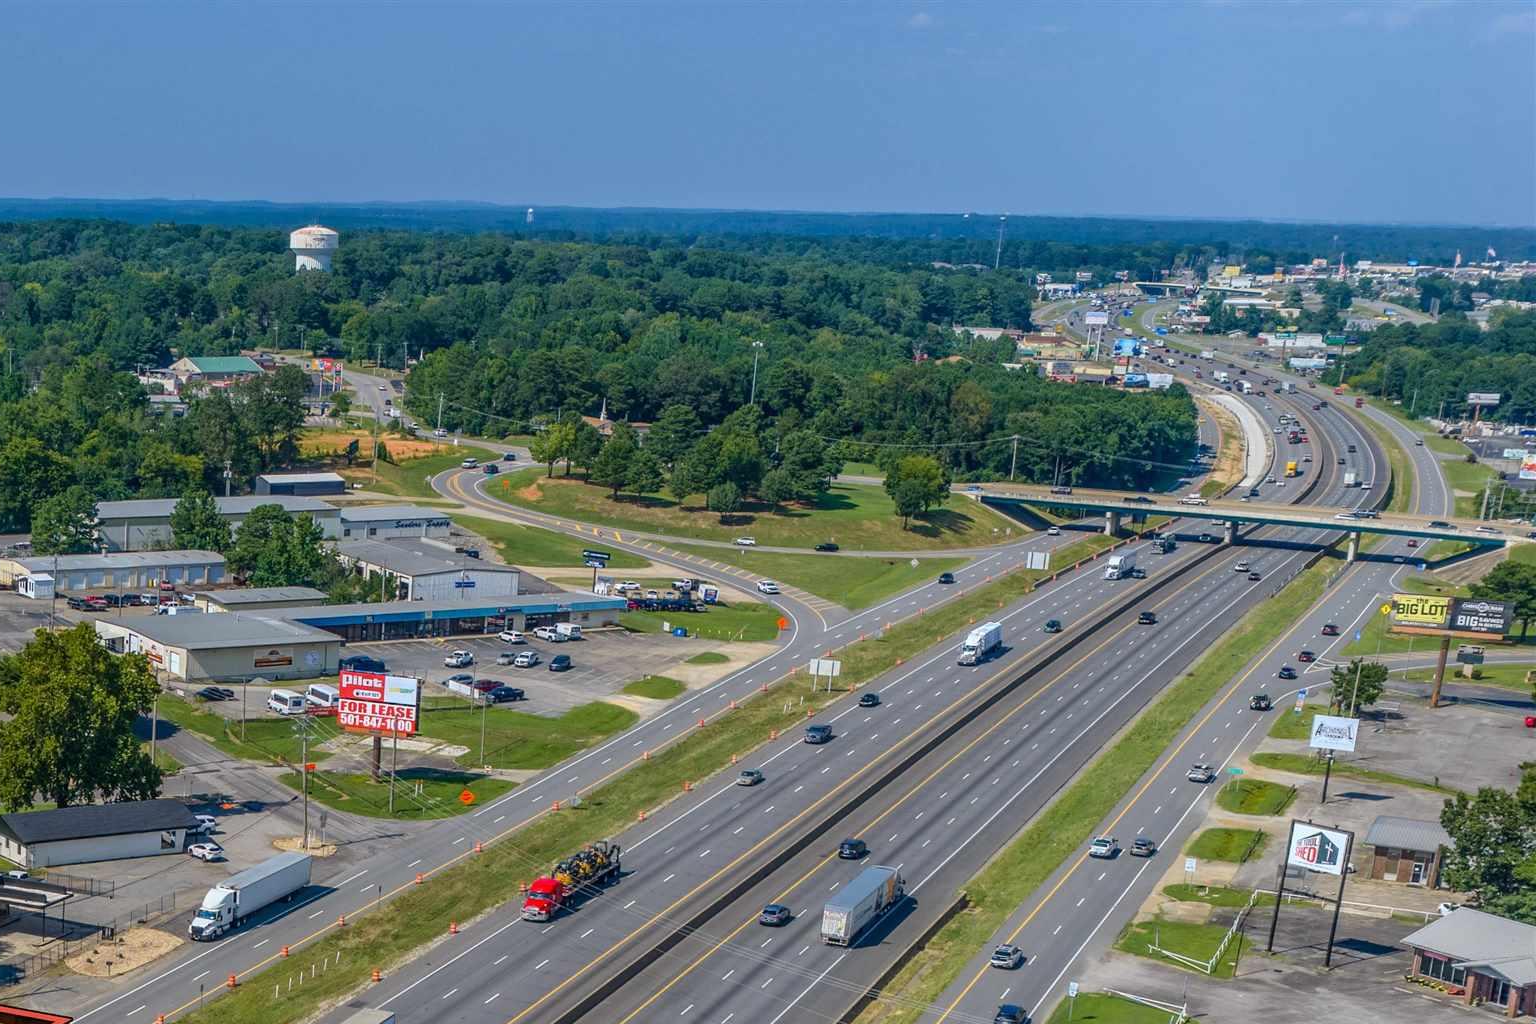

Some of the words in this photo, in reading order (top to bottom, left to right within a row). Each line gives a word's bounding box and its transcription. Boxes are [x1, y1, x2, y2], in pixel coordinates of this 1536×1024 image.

[1396, 603, 1419, 615] BIG
[1421, 604, 1447, 616] LOT
[1457, 615, 1479, 627] BIG
[340, 700, 368, 714] FOR
[371, 703, 414, 720] LEASE
